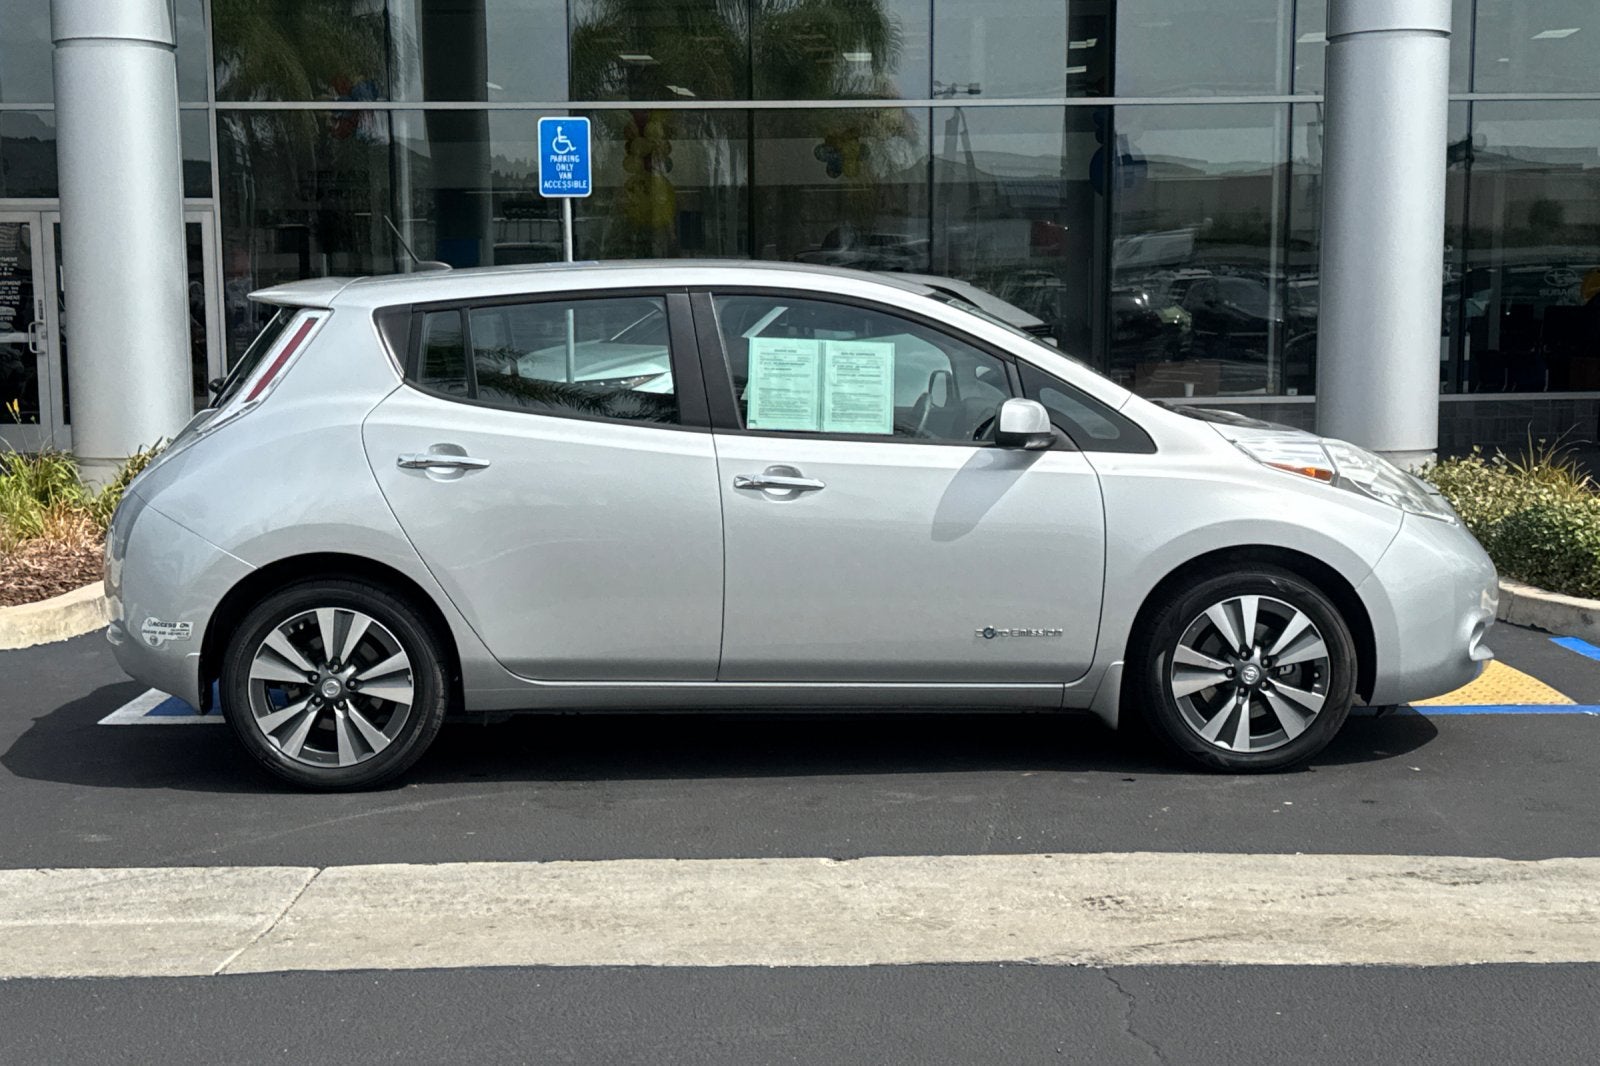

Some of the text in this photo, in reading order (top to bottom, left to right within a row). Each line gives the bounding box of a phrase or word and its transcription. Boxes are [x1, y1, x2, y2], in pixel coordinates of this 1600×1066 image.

[550, 154, 580, 163] PARKING
[555, 163, 574, 171] ONLY
[558, 171, 572, 180] VAN
[543, 180, 588, 189] ACCESSIBLE
[1011, 627, 1064, 638] Emission
